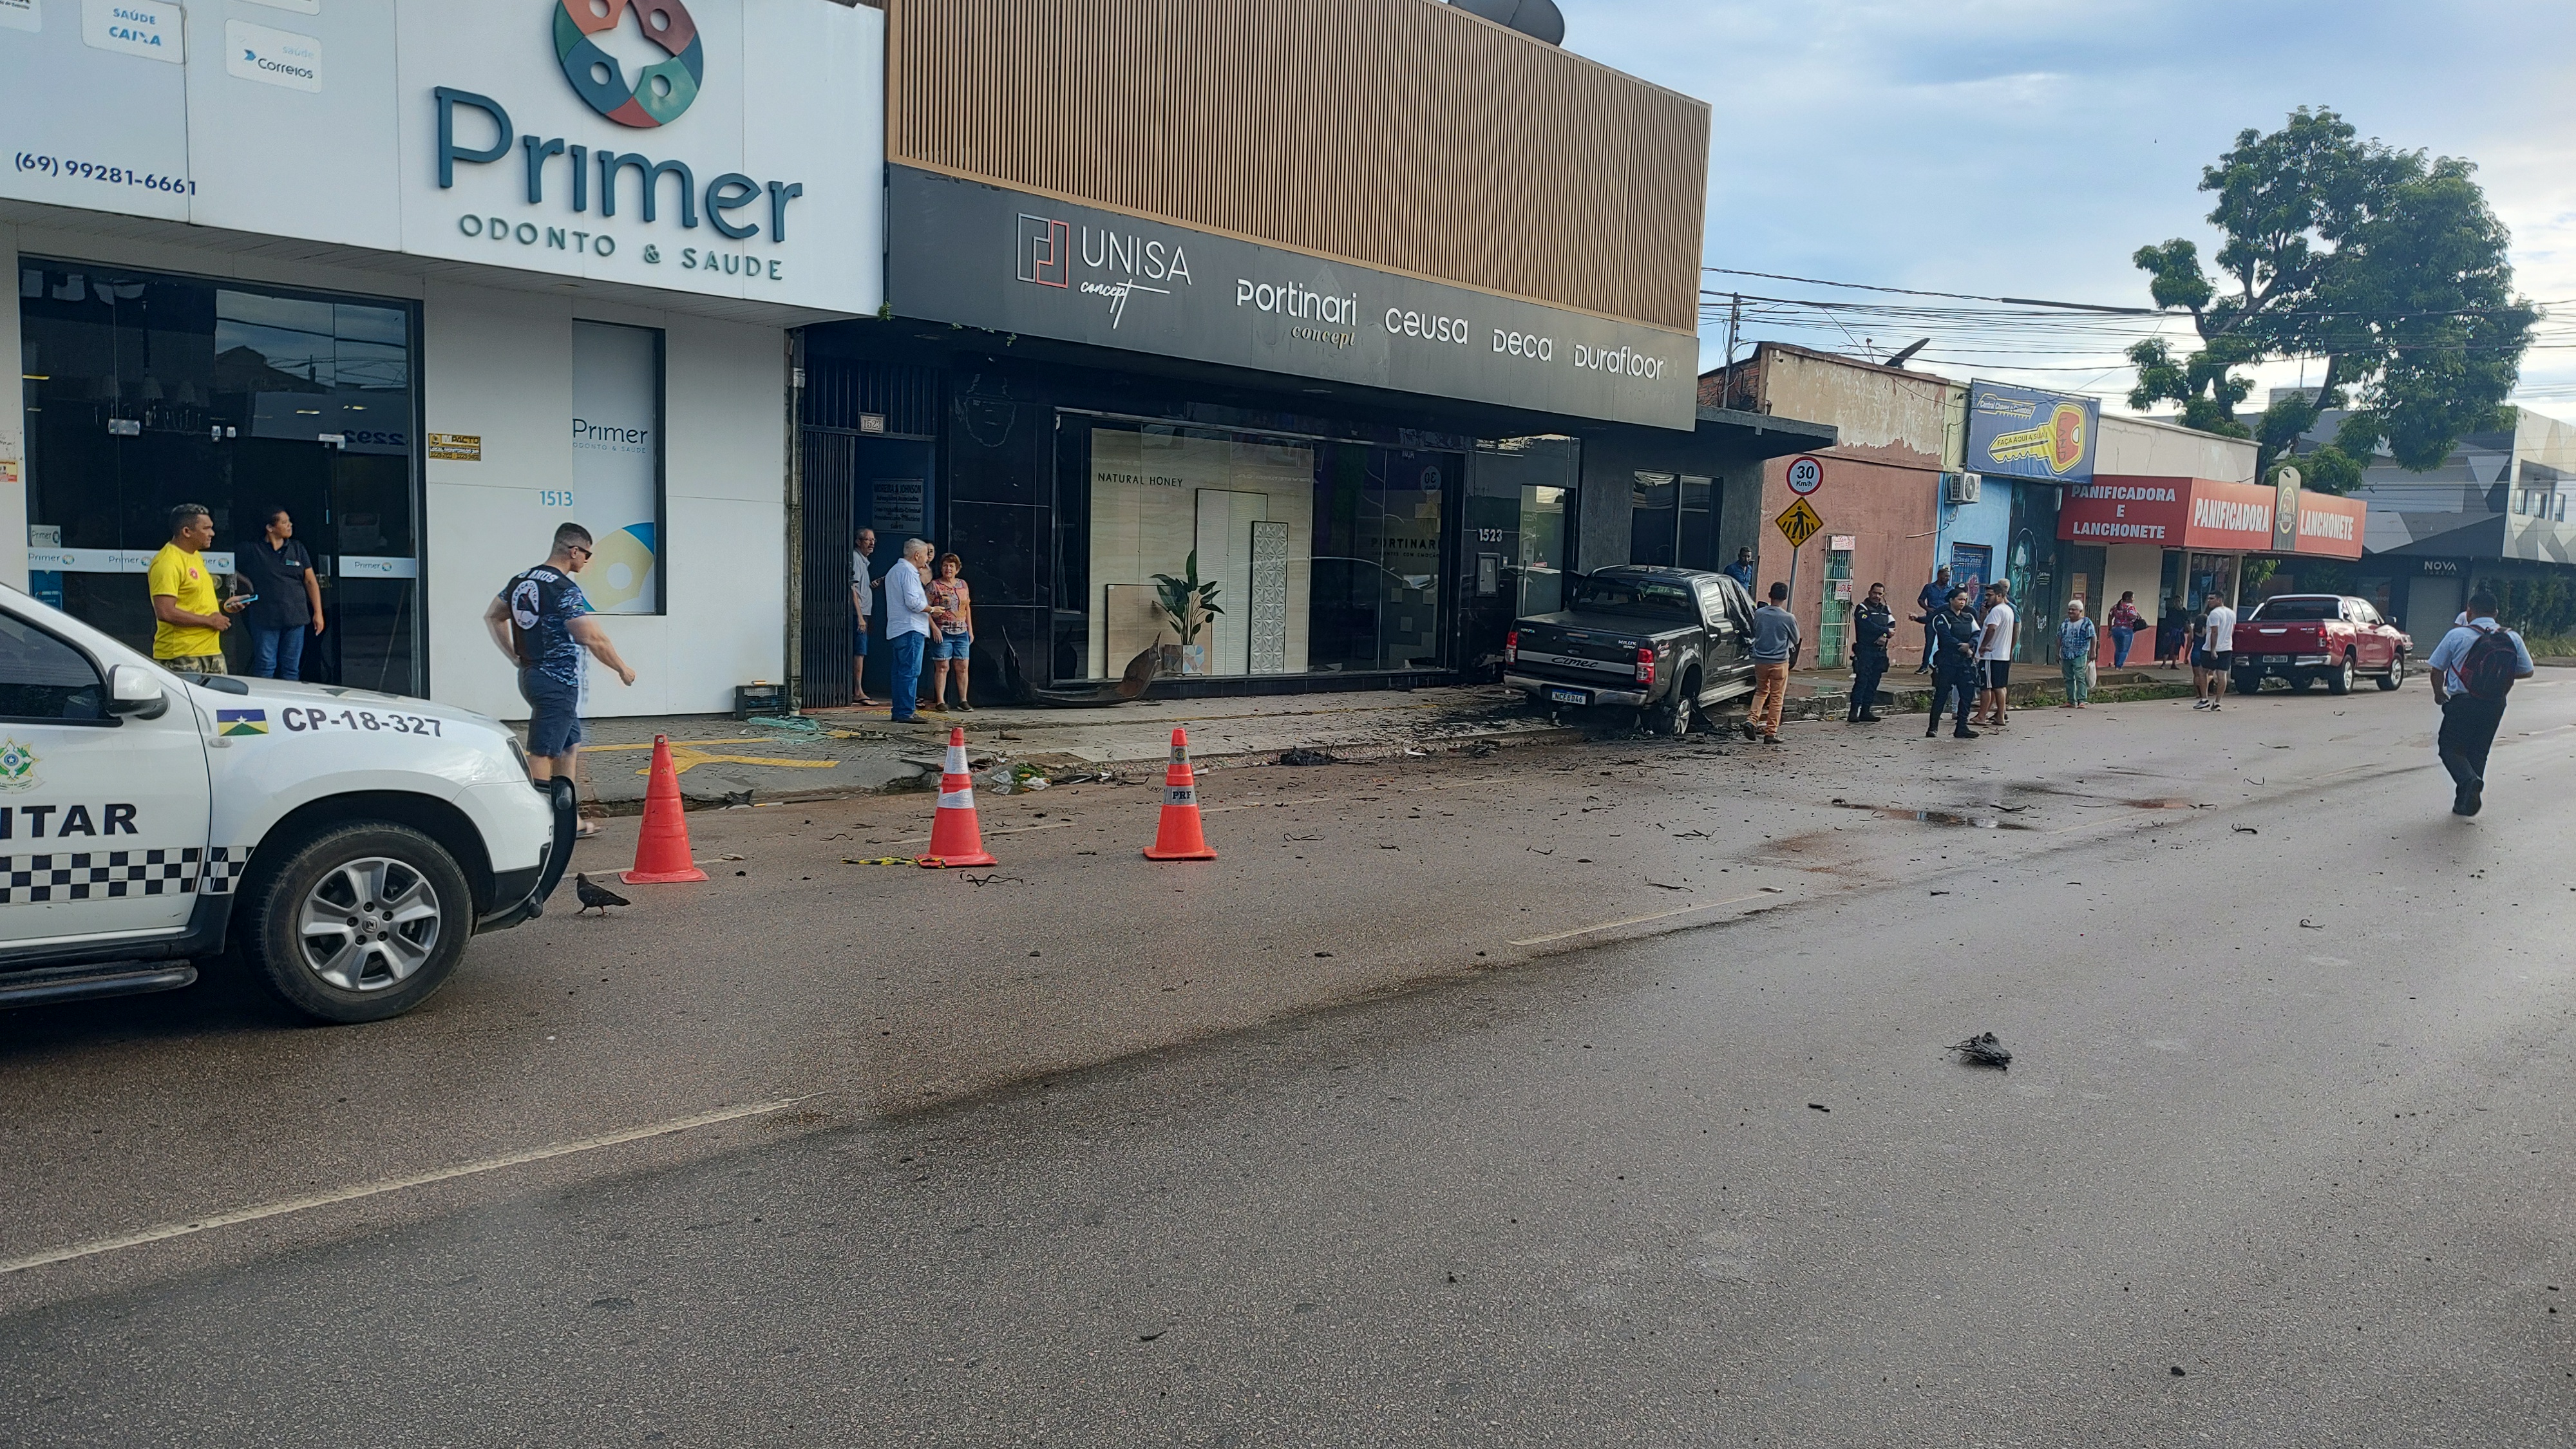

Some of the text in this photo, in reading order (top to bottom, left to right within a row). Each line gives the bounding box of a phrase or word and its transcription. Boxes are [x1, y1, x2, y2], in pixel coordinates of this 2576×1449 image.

[113, 8, 156, 25] SAÚDE
[109, 26, 161, 46] CAIXA
[258, 58, 313, 79] Correios
[434, 85, 803, 242] Primer
[15, 152, 196, 196] (69) 99281-6661
[459, 214, 784, 281] ODONTO & SAUDE
[1081, 224, 1192, 286] UNISA
[1079, 278, 1171, 330] concept
[1236, 278, 1357, 327] Portinari
[1492, 328, 1553, 362] Deca
[1573, 344, 1664, 381] Durafloor
[1291, 325, 1356, 349] concept
[572, 418, 648, 444] Primer
[863, 419, 882, 430] 1523
[441, 435, 479, 444] IMPACTO
[572, 442, 608, 451] ODONTO
[621, 446, 647, 454] SAUDE
[1997, 438, 2013, 446] FAÇA
[1098, 472, 1184, 488] NATURAL HONEY
[1796, 465, 1815, 479] 30
[540, 490, 573, 507] 1513
[2071, 485, 2176, 502] PANIFICADORA
[2116, 504, 2125, 518] E
[2193, 497, 2269, 533] PANIFICADORA
[2072, 521, 2166, 539] LANCHONETE
[2299, 509, 2354, 541] LANCHONETE
[32, 529, 52, 540] Primer
[1479, 528, 1502, 542] 1523
[28, 552, 61, 562] Primer
[354, 561, 381, 570] Primer
[2423, 560, 2457, 571] NOVA
[1551, 656, 1599, 668] Cimec
[281, 707, 442, 738] CP-18-327
[1172, 791, 1191, 800] PRF
[0, 803, 139, 840] ITAR
